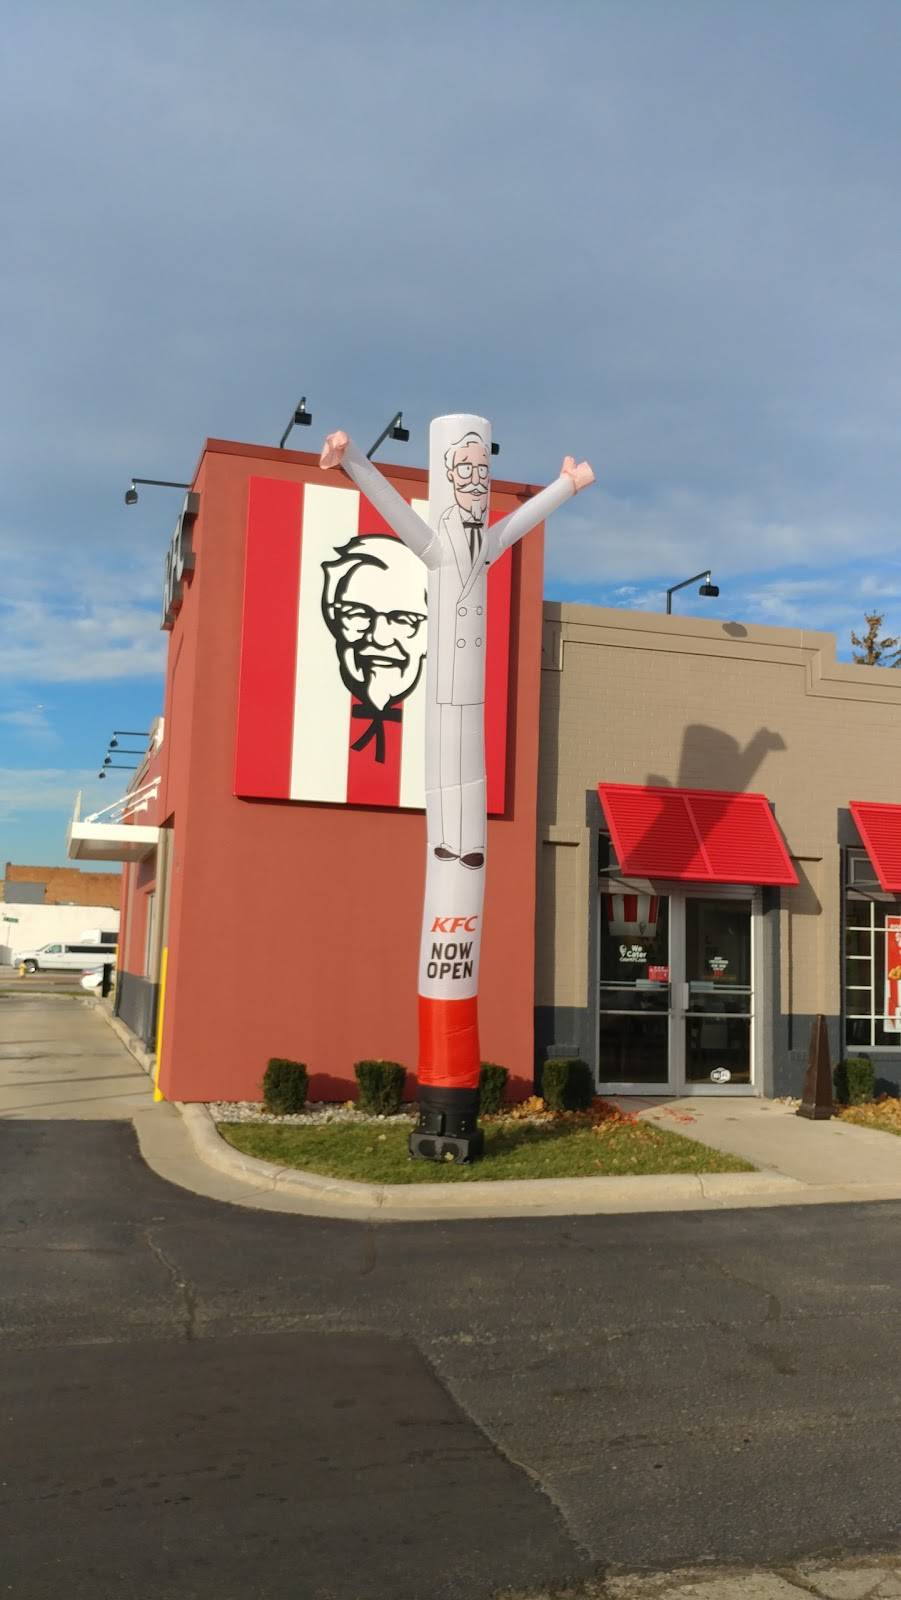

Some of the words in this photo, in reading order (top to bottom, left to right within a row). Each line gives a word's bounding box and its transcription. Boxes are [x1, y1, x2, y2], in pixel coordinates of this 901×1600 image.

[431, 915, 478, 933] KFC
[431, 941, 473, 960] NOW
[626, 950, 647, 959] Cater
[631, 944, 643, 952] We
[427, 960, 473, 980] OPEN
